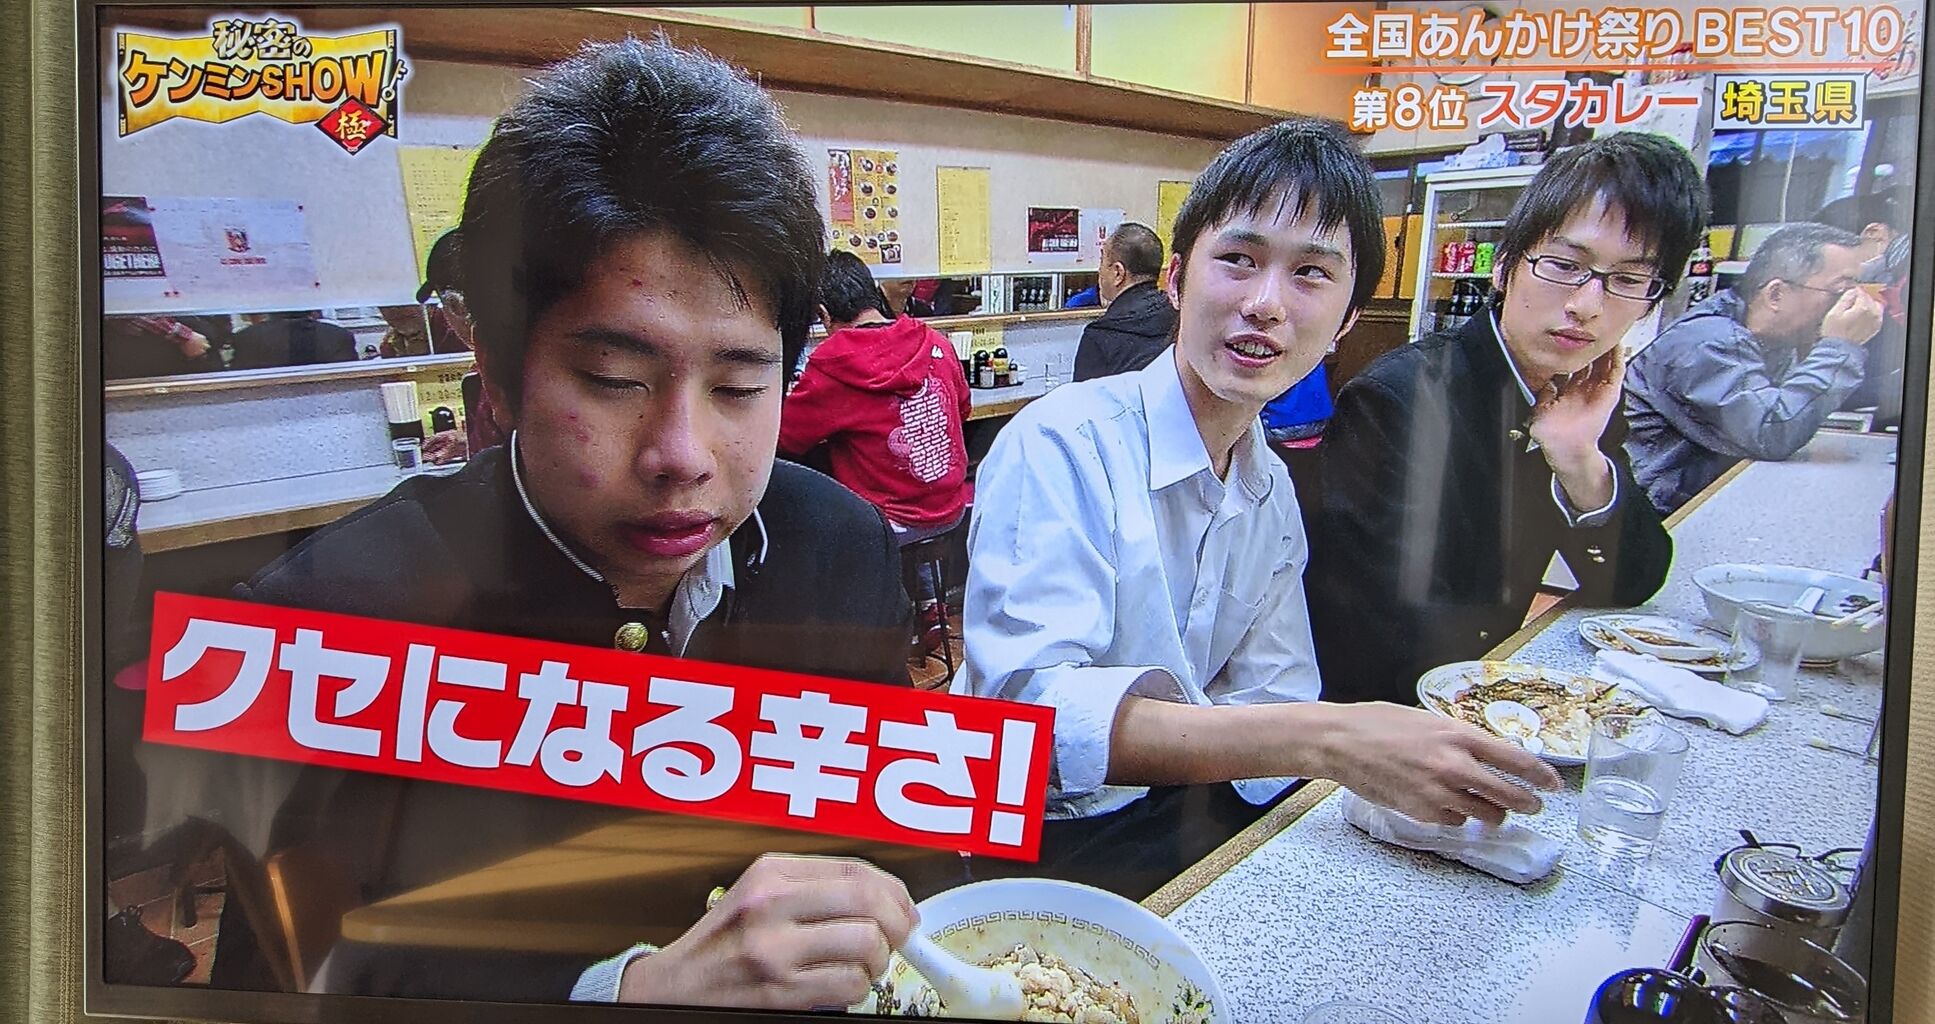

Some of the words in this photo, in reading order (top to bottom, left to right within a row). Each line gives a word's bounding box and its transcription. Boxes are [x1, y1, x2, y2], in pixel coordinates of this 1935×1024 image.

[213, 18, 312, 60] 秘密の
[1326, 11, 1681, 58] 全国あんかけ祭り
[1698, 10, 1901, 55] BEST10
[334, 110, 371, 140] 極
[1352, 86, 1466, 129] 第8位
[1480, 82, 1699, 126] スタカレー
[1721, 80, 1856, 123] 埼玉県
[161, 616, 1037, 847] クセになる辛さ!
